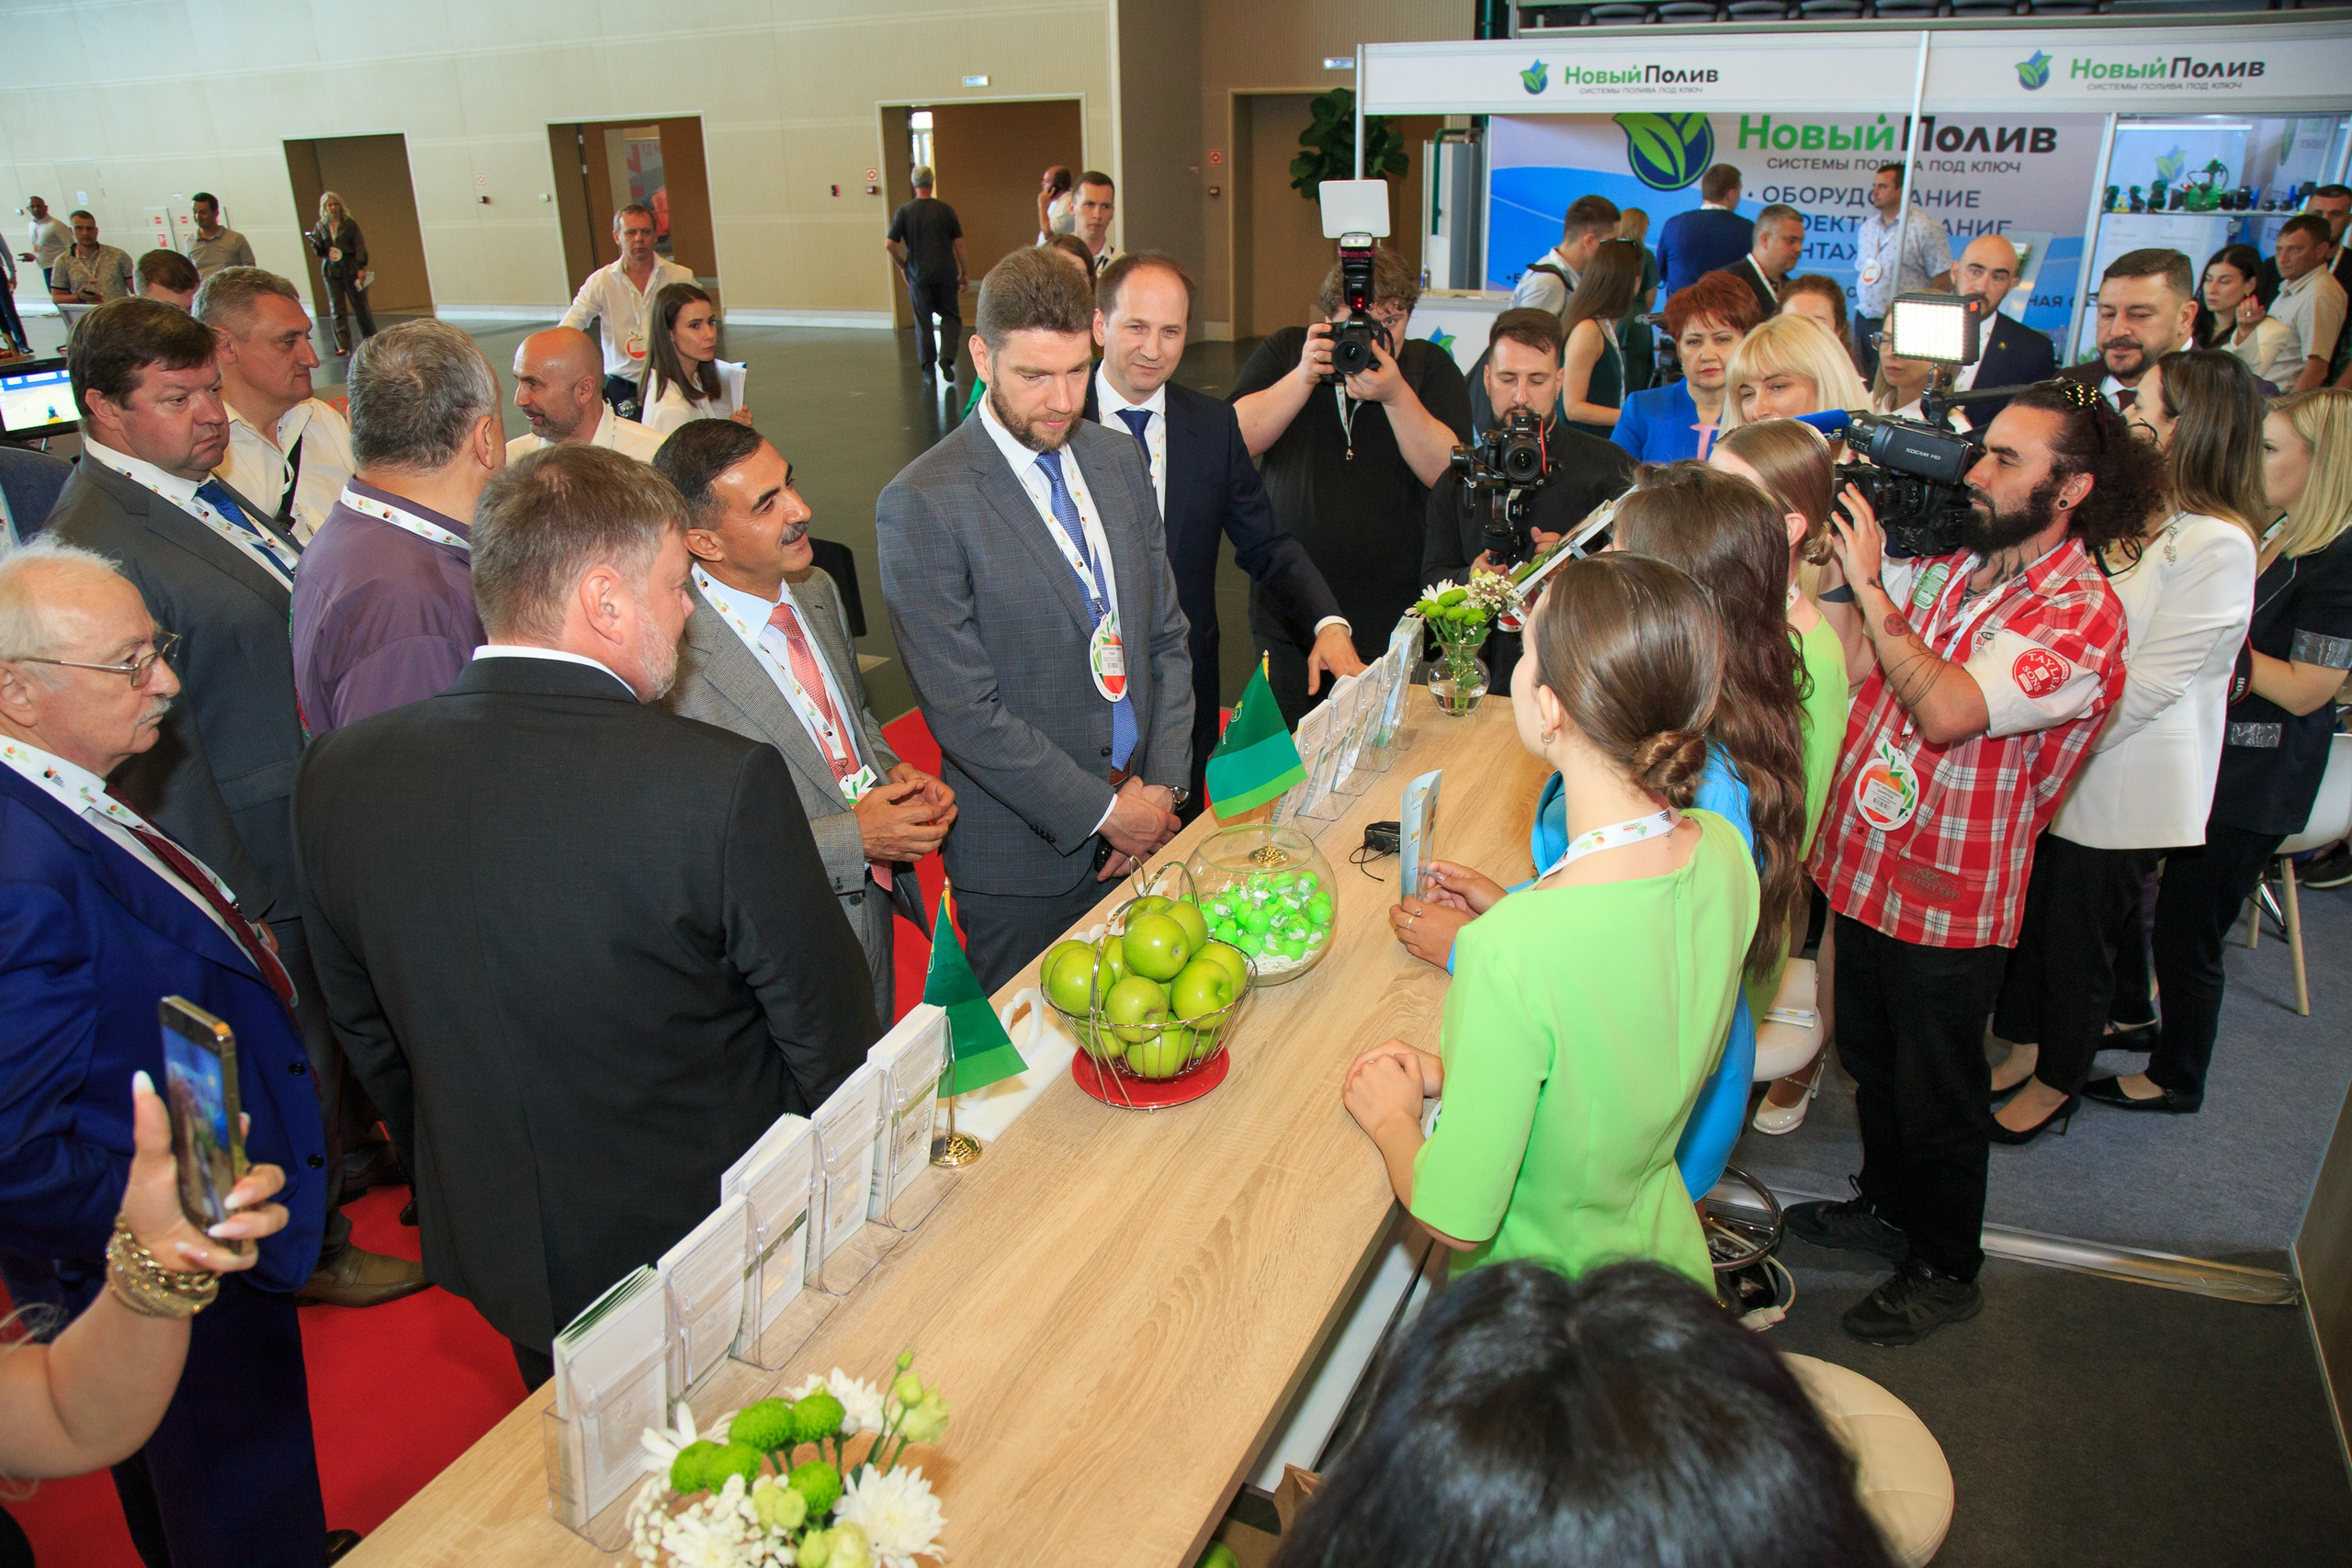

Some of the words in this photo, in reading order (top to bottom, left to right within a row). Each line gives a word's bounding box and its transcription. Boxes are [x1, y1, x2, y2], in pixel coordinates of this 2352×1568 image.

[2086, 83, 2137, 91] СИСТЕМЫ
[2141, 82, 2183, 90] ПОЛИВА
[2186, 82, 2208, 91] ПОД
[2211, 82, 2243, 90] КЛЮЧ
[1767, 157, 1849, 170] СИСТЕМЫ
[1928, 160, 1965, 173] ПОД
[1971, 161, 2020, 173] КЛЮЧ
[2021, 665, 2042, 692] SONS
